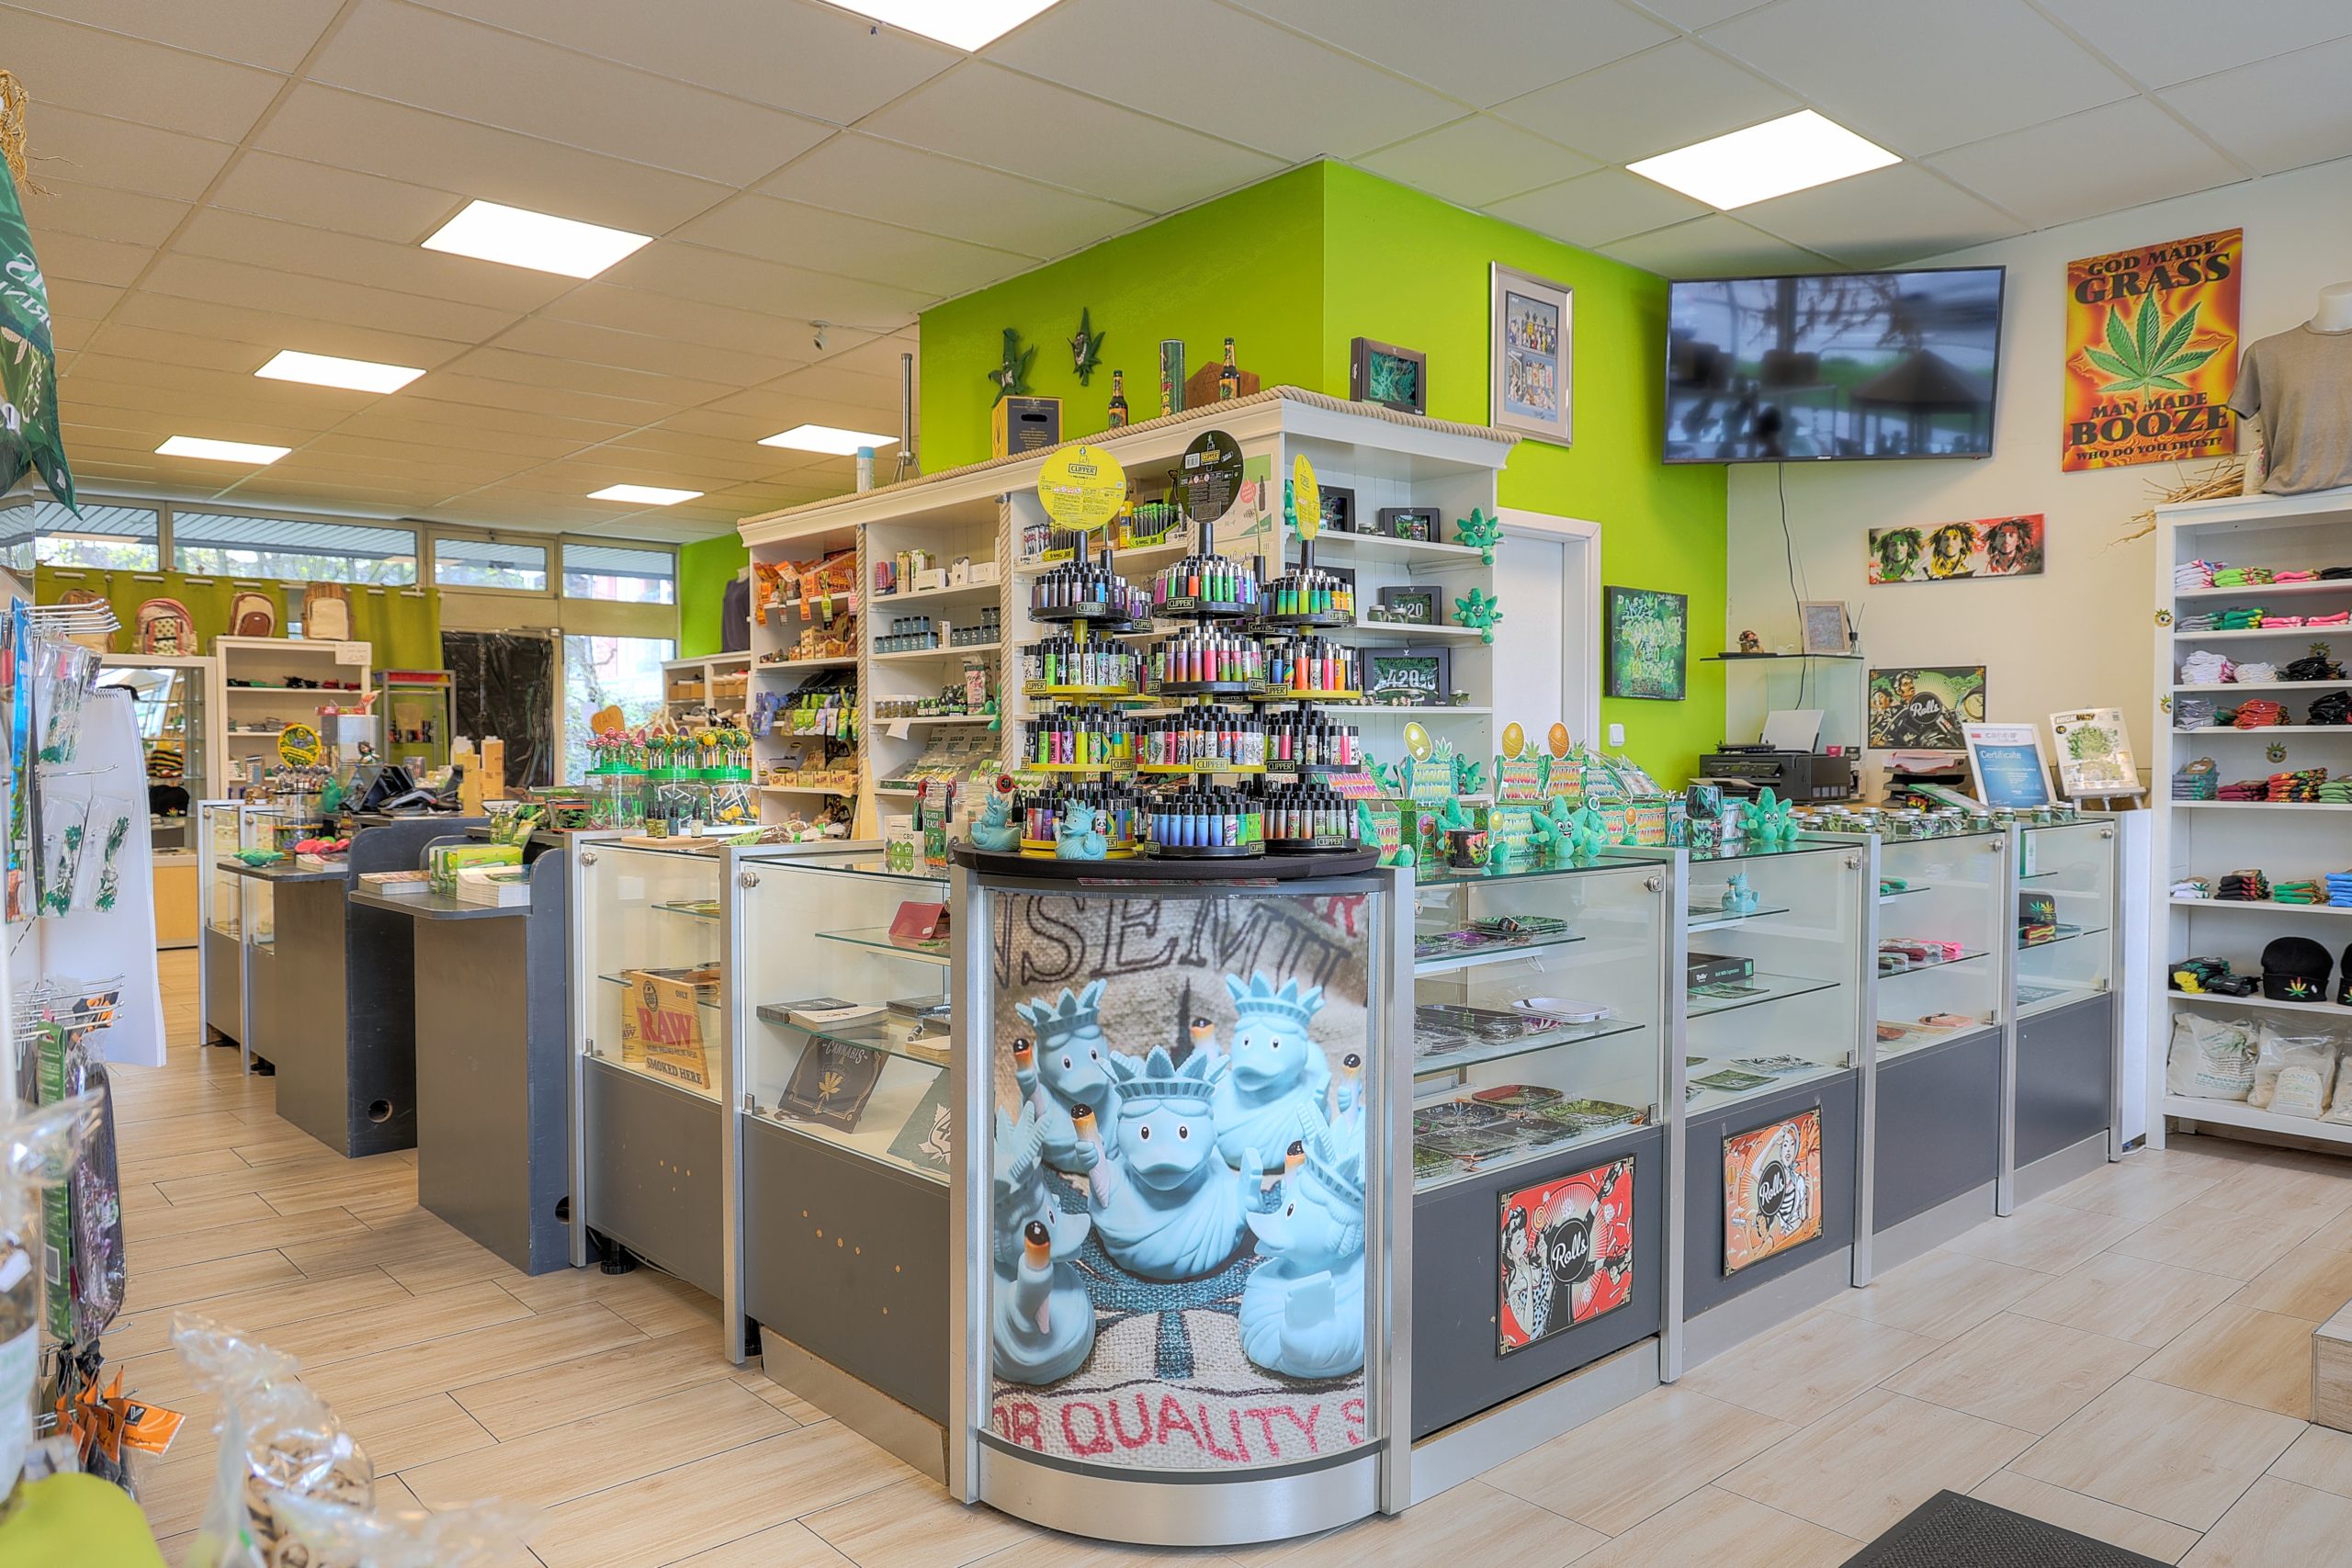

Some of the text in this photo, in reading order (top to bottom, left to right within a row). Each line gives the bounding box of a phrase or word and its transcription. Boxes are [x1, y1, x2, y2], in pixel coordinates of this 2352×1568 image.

[2087, 240, 2216, 276] GOD MADE
[2075, 252, 2231, 305] GRASS
[2091, 392, 2208, 419] MAN MADE
[2070, 404, 2230, 446] BOOZE
[2076, 435, 2223, 460] WHO DO YOU TRUST?
[1070, 465, 1095, 474] CLIPPER
[1079, 604, 1103, 613] CLIPPER
[1168, 599, 1193, 608] CLIPPER
[1328, 612, 1348, 621] CLIPPER
[1026, 682, 1046, 690] CLIPPER
[1387, 670, 1419, 689] 420
[1910, 698, 1941, 717] Rolls
[1113, 759, 1132, 769] CLIPPER
[1980, 750, 2022, 759] Certificate
[1196, 760, 1226, 769] CLIPPER
[1268, 762, 1294, 772] CLIPPER
[1317, 837, 1342, 846] CLIPPER
[636, 1007, 692, 1049] RAW
[826, 1040, 865, 1065] CANNABIS
[646, 1057, 703, 1086] SMOKED HERE
[1758, 1172, 1786, 1206] Rolls
[1551, 1234, 1589, 1271] Rolls
[1059, 1393, 1320, 1463] QUALITY
